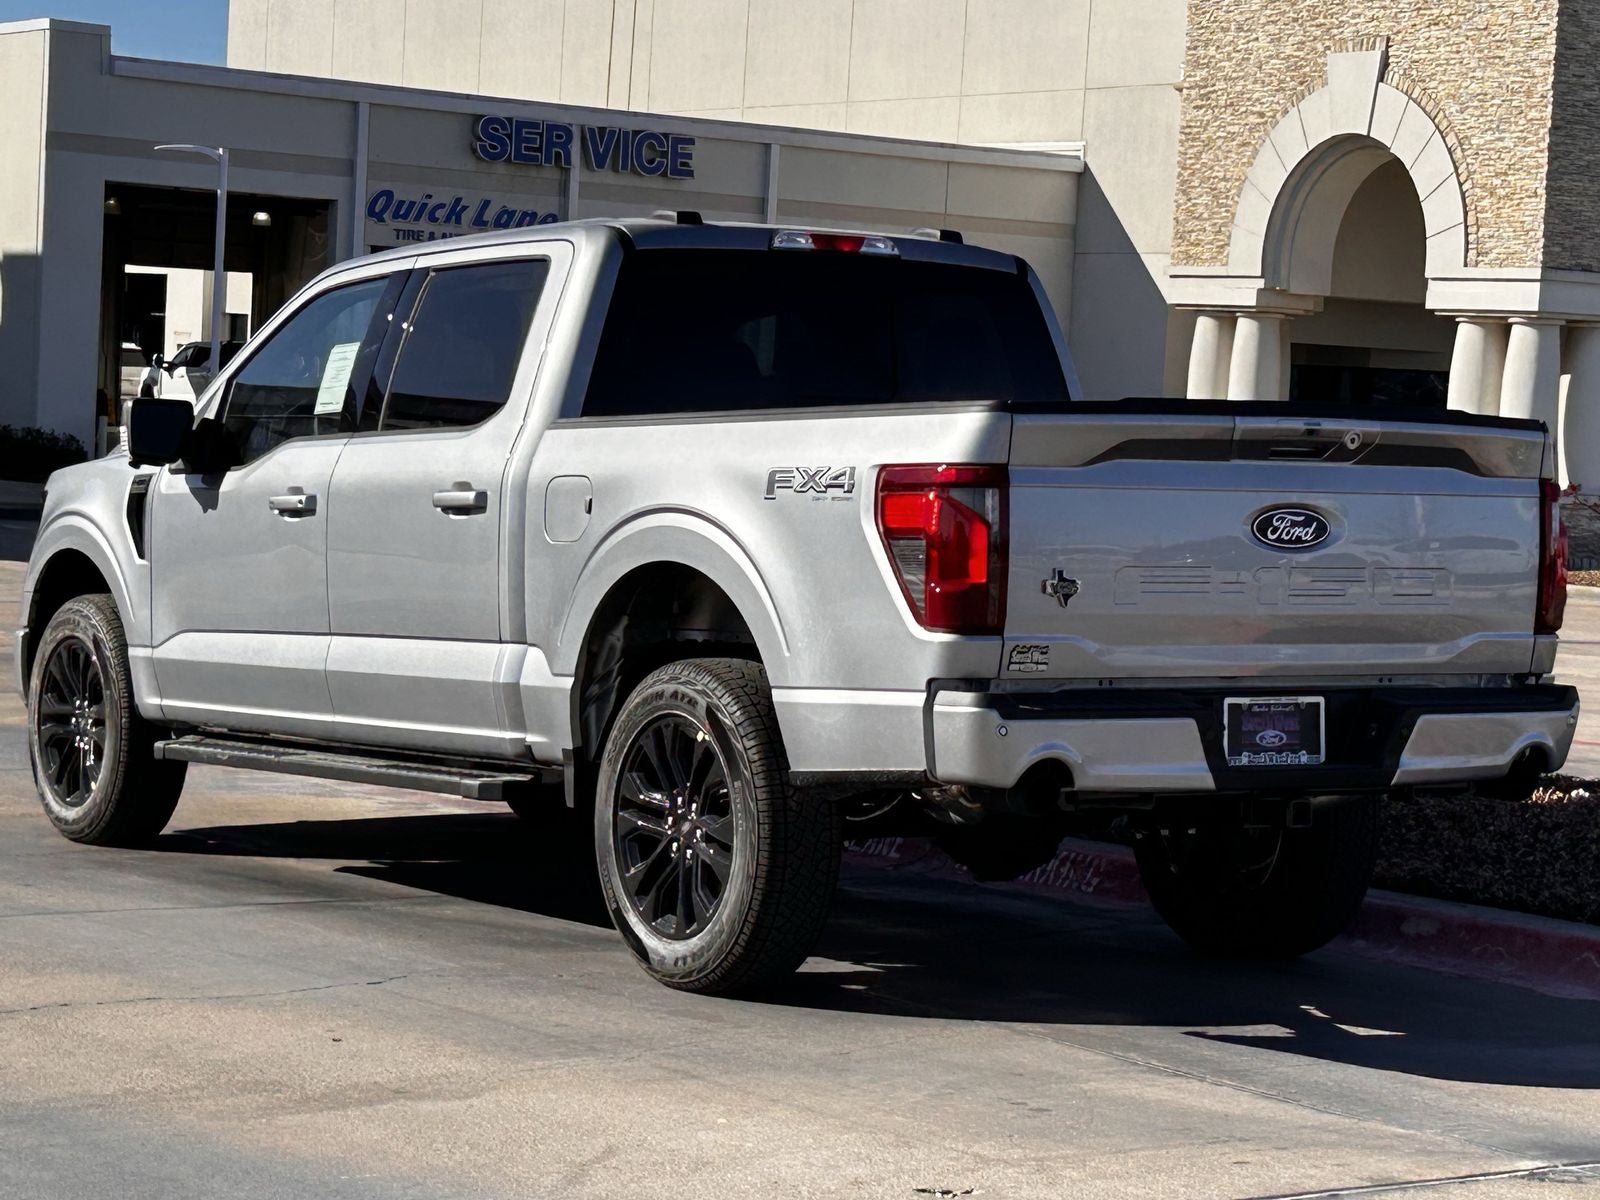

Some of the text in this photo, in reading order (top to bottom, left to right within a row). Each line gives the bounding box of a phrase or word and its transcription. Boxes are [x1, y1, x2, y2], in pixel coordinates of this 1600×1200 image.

[473, 115, 696, 179] SERVICE
[366, 190, 469, 226] Quick
[393, 228, 424, 242] TIRE
[764, 465, 856, 499] FX4
[1267, 514, 1317, 541] Ford
